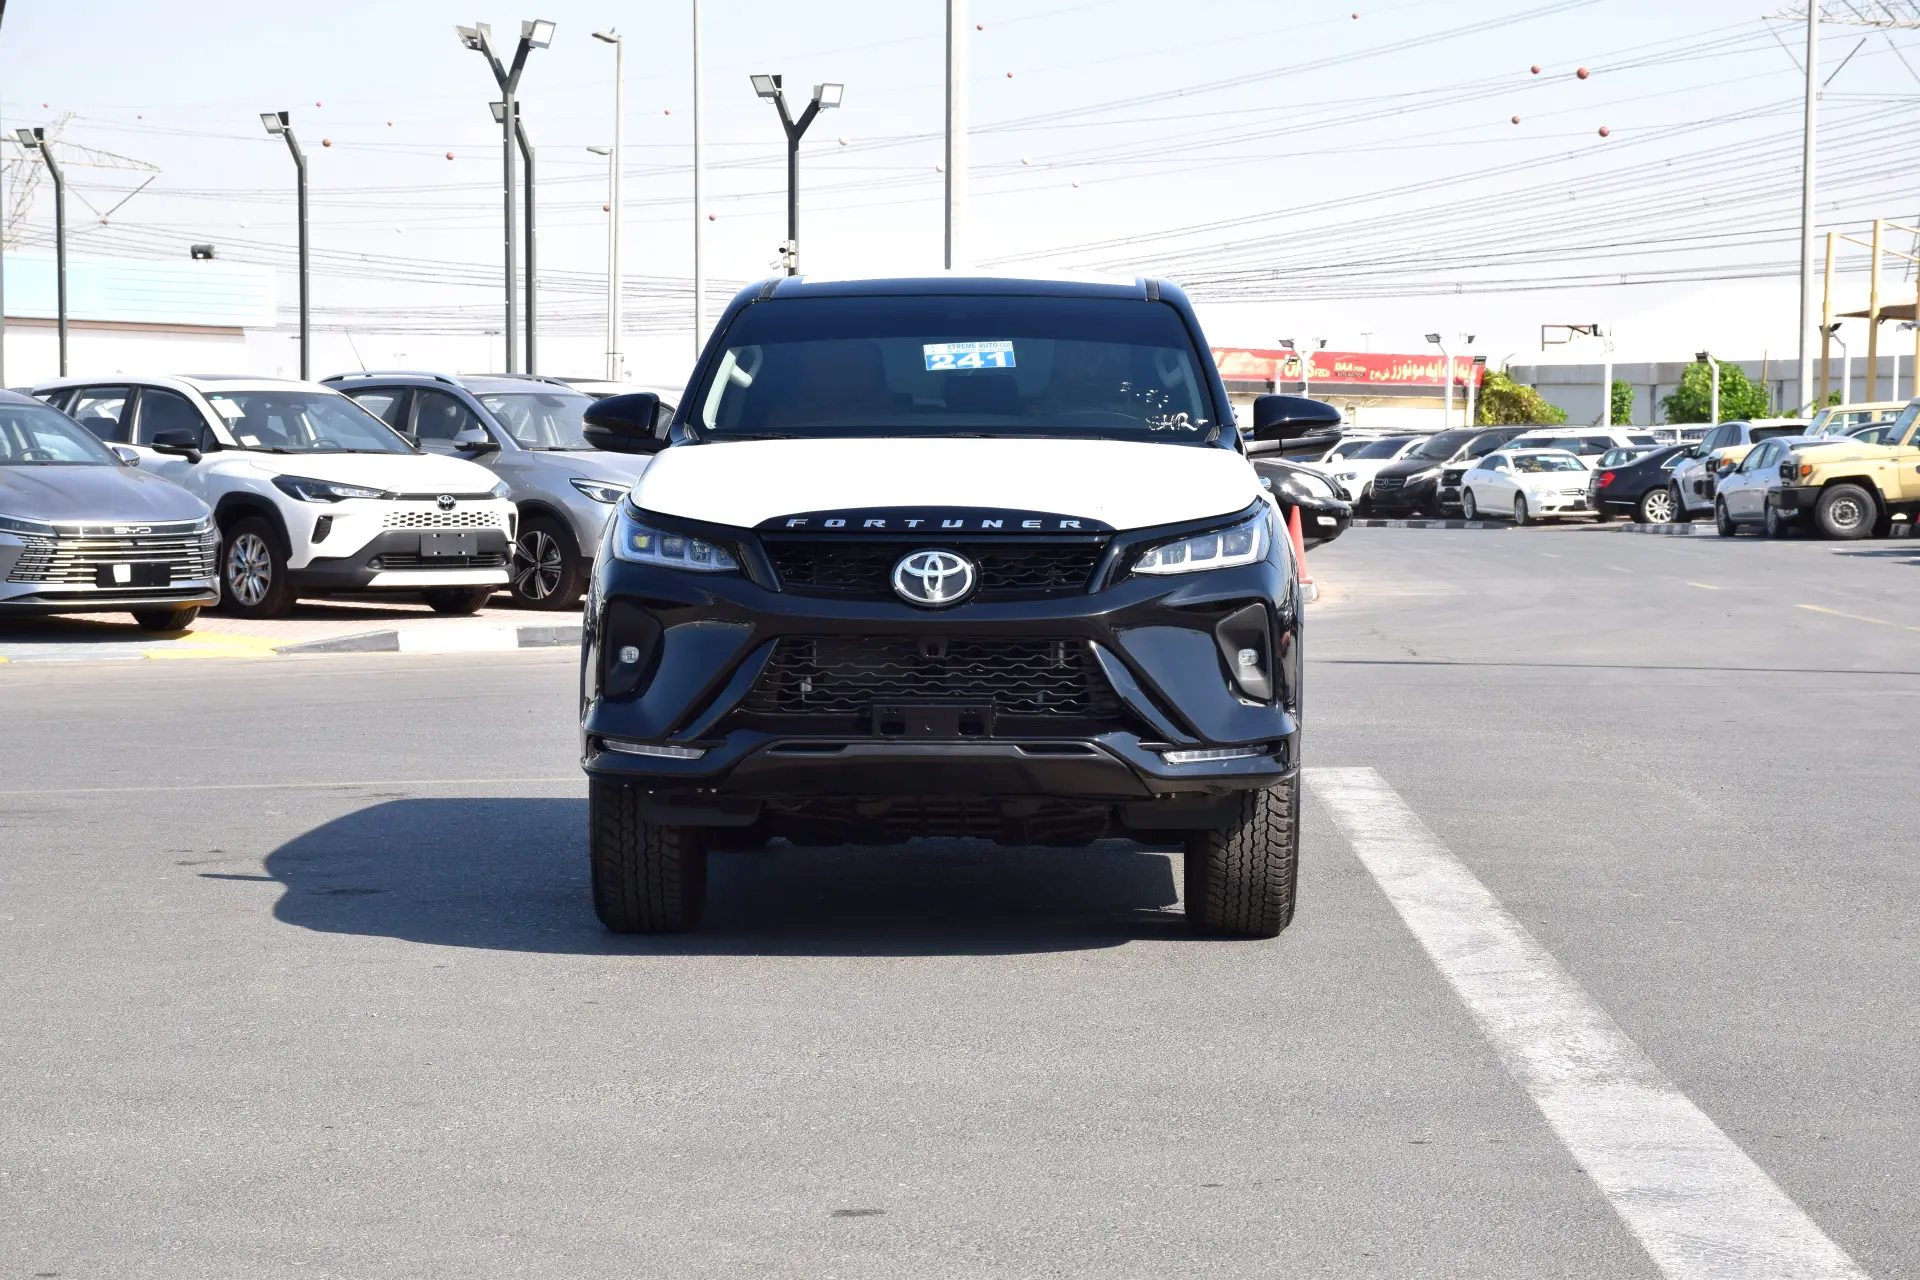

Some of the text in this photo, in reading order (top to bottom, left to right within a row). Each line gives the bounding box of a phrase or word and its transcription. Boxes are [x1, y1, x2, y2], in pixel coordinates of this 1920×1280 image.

[946, 342, 977, 350] XTREME
[930, 352, 1007, 370] 241
[1334, 362, 1353, 372] DAA
[785, 518, 1082, 528] FORTUNER
[113, 526, 152, 534] BYD
